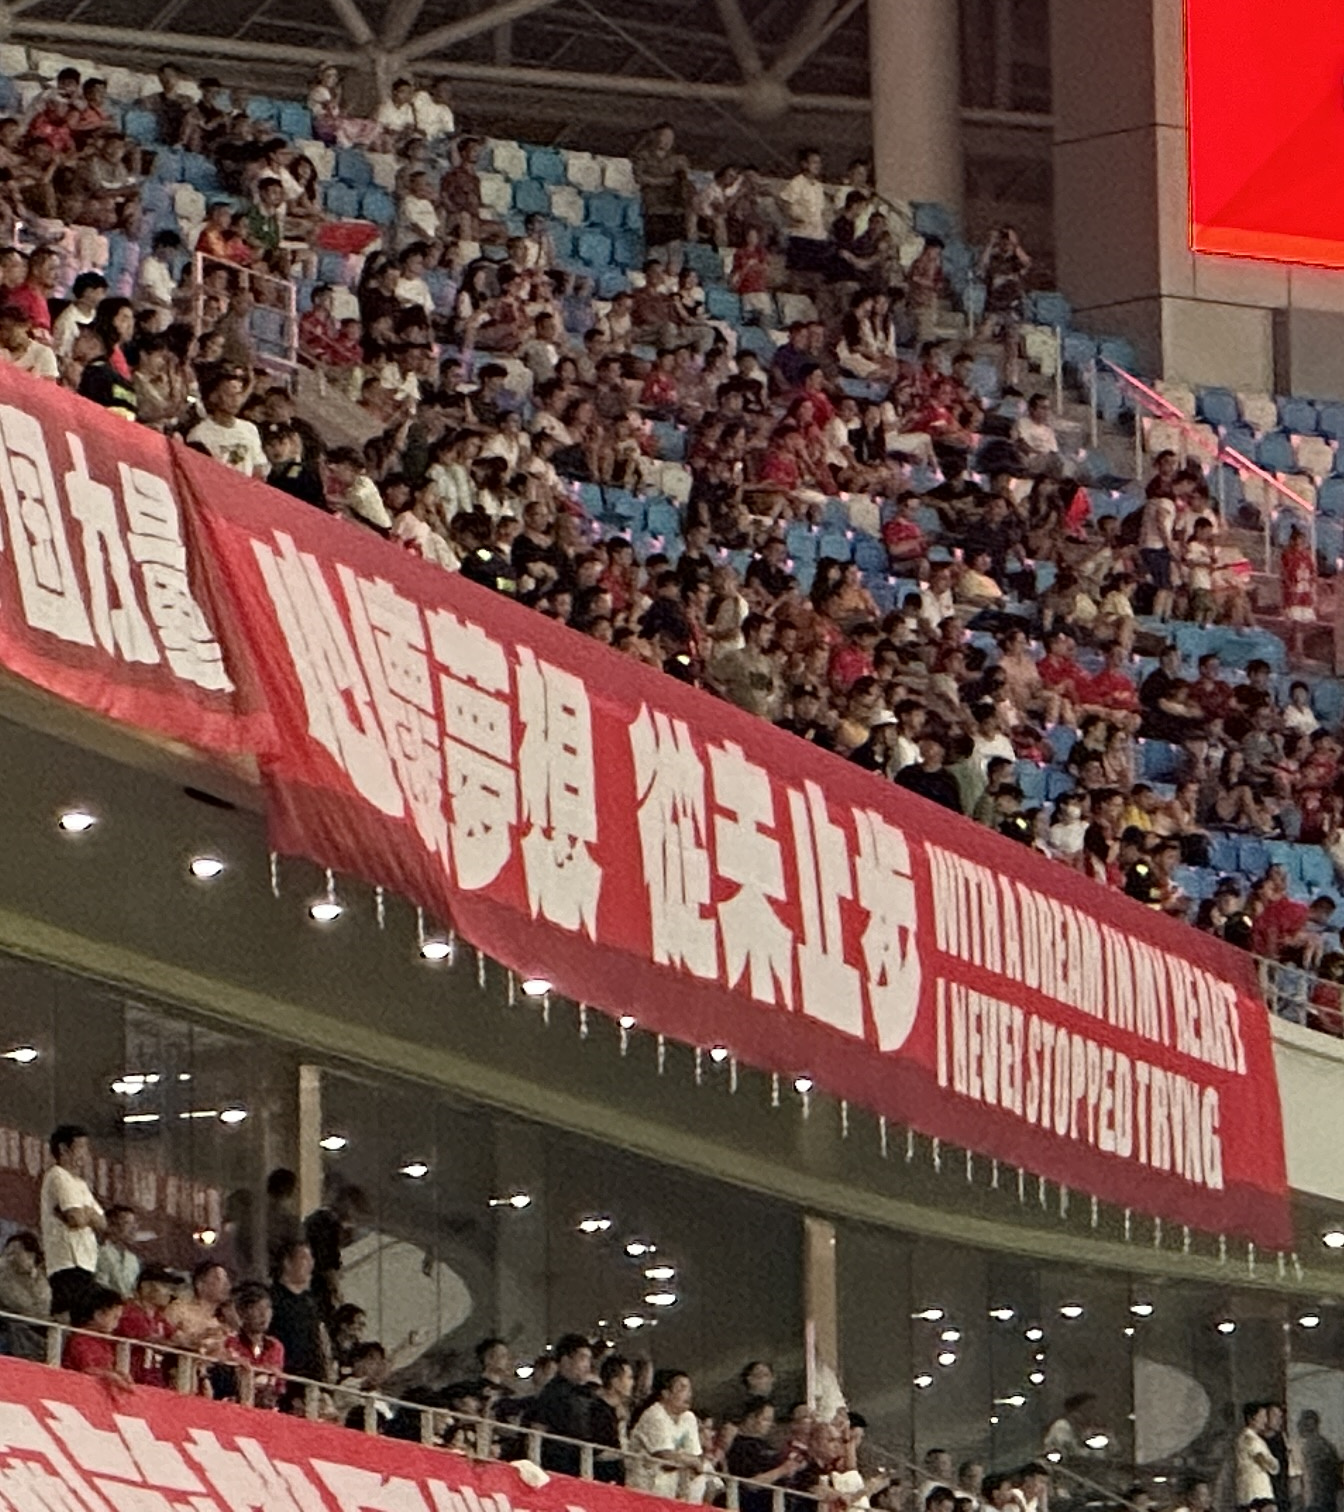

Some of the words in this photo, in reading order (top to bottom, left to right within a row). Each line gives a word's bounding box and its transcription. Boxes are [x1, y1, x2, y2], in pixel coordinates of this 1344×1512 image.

[0, 402, 236, 694] 国力量
[923, 839, 1002, 975] WITH
[1024, 1012, 1133, 1159] STOPPED
